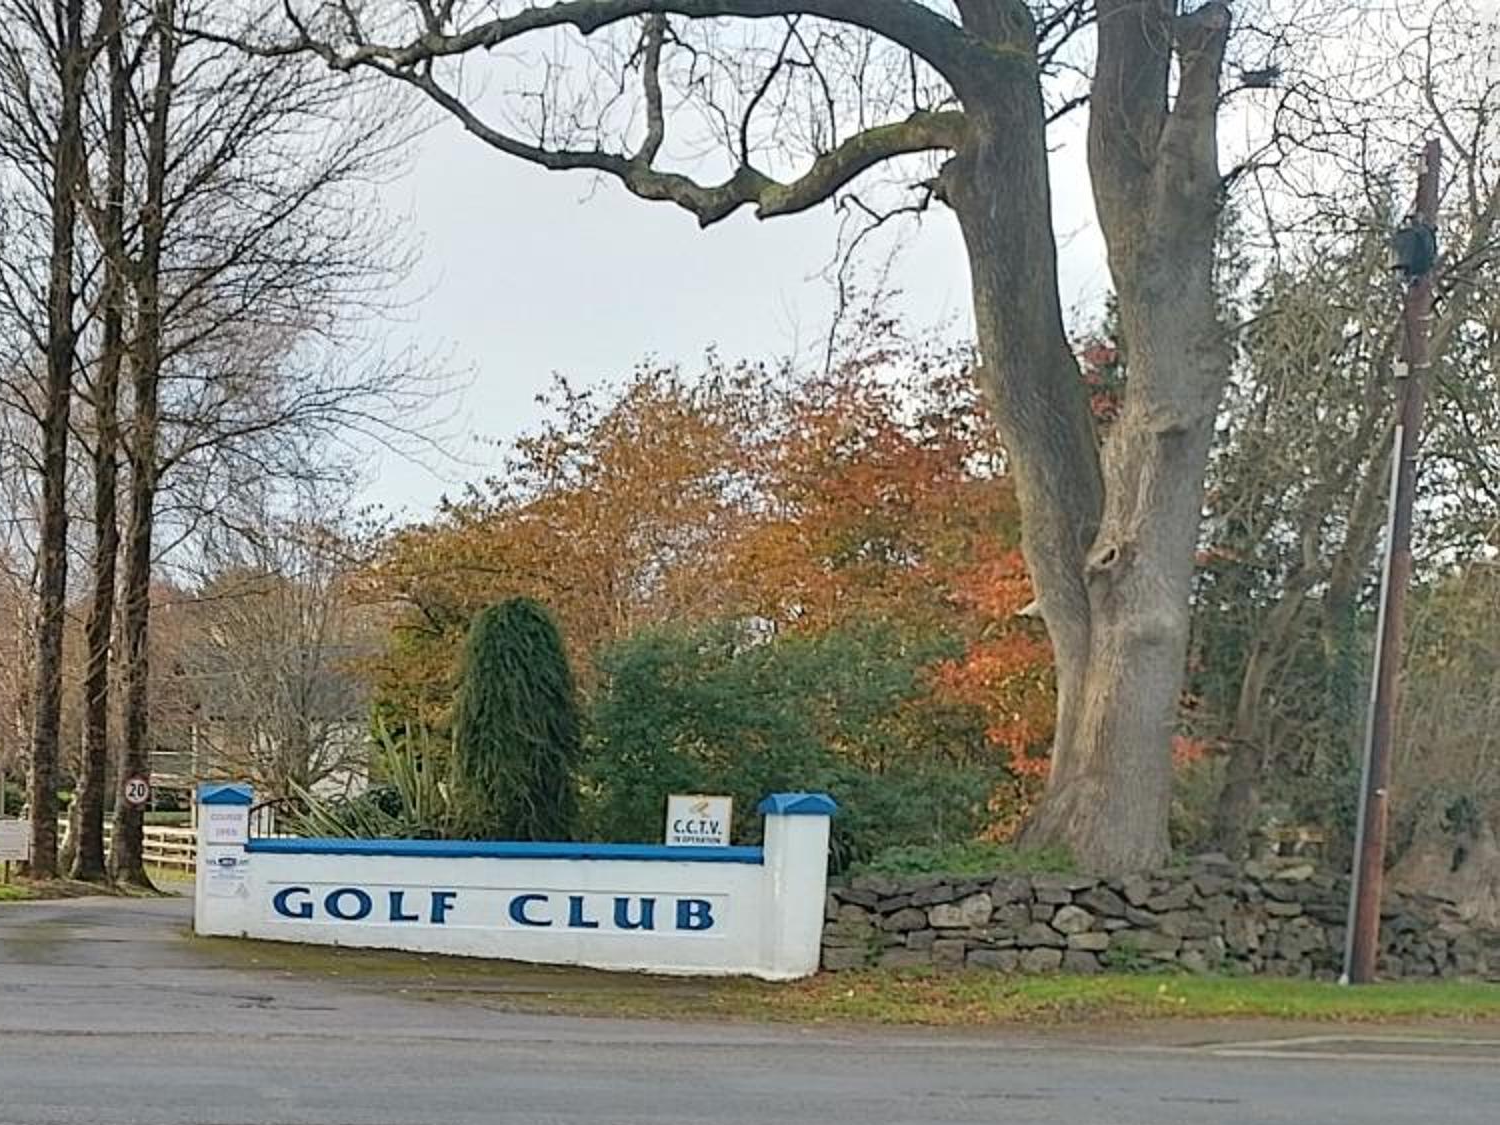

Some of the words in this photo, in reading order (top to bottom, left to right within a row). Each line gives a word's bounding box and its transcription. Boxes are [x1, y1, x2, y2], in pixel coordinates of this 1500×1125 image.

[128, 783, 145, 797] 20
[673, 818, 723, 835] C.C.T.V.
[272, 886, 458, 925] GOLF
[508, 893, 715, 931] CLUB
